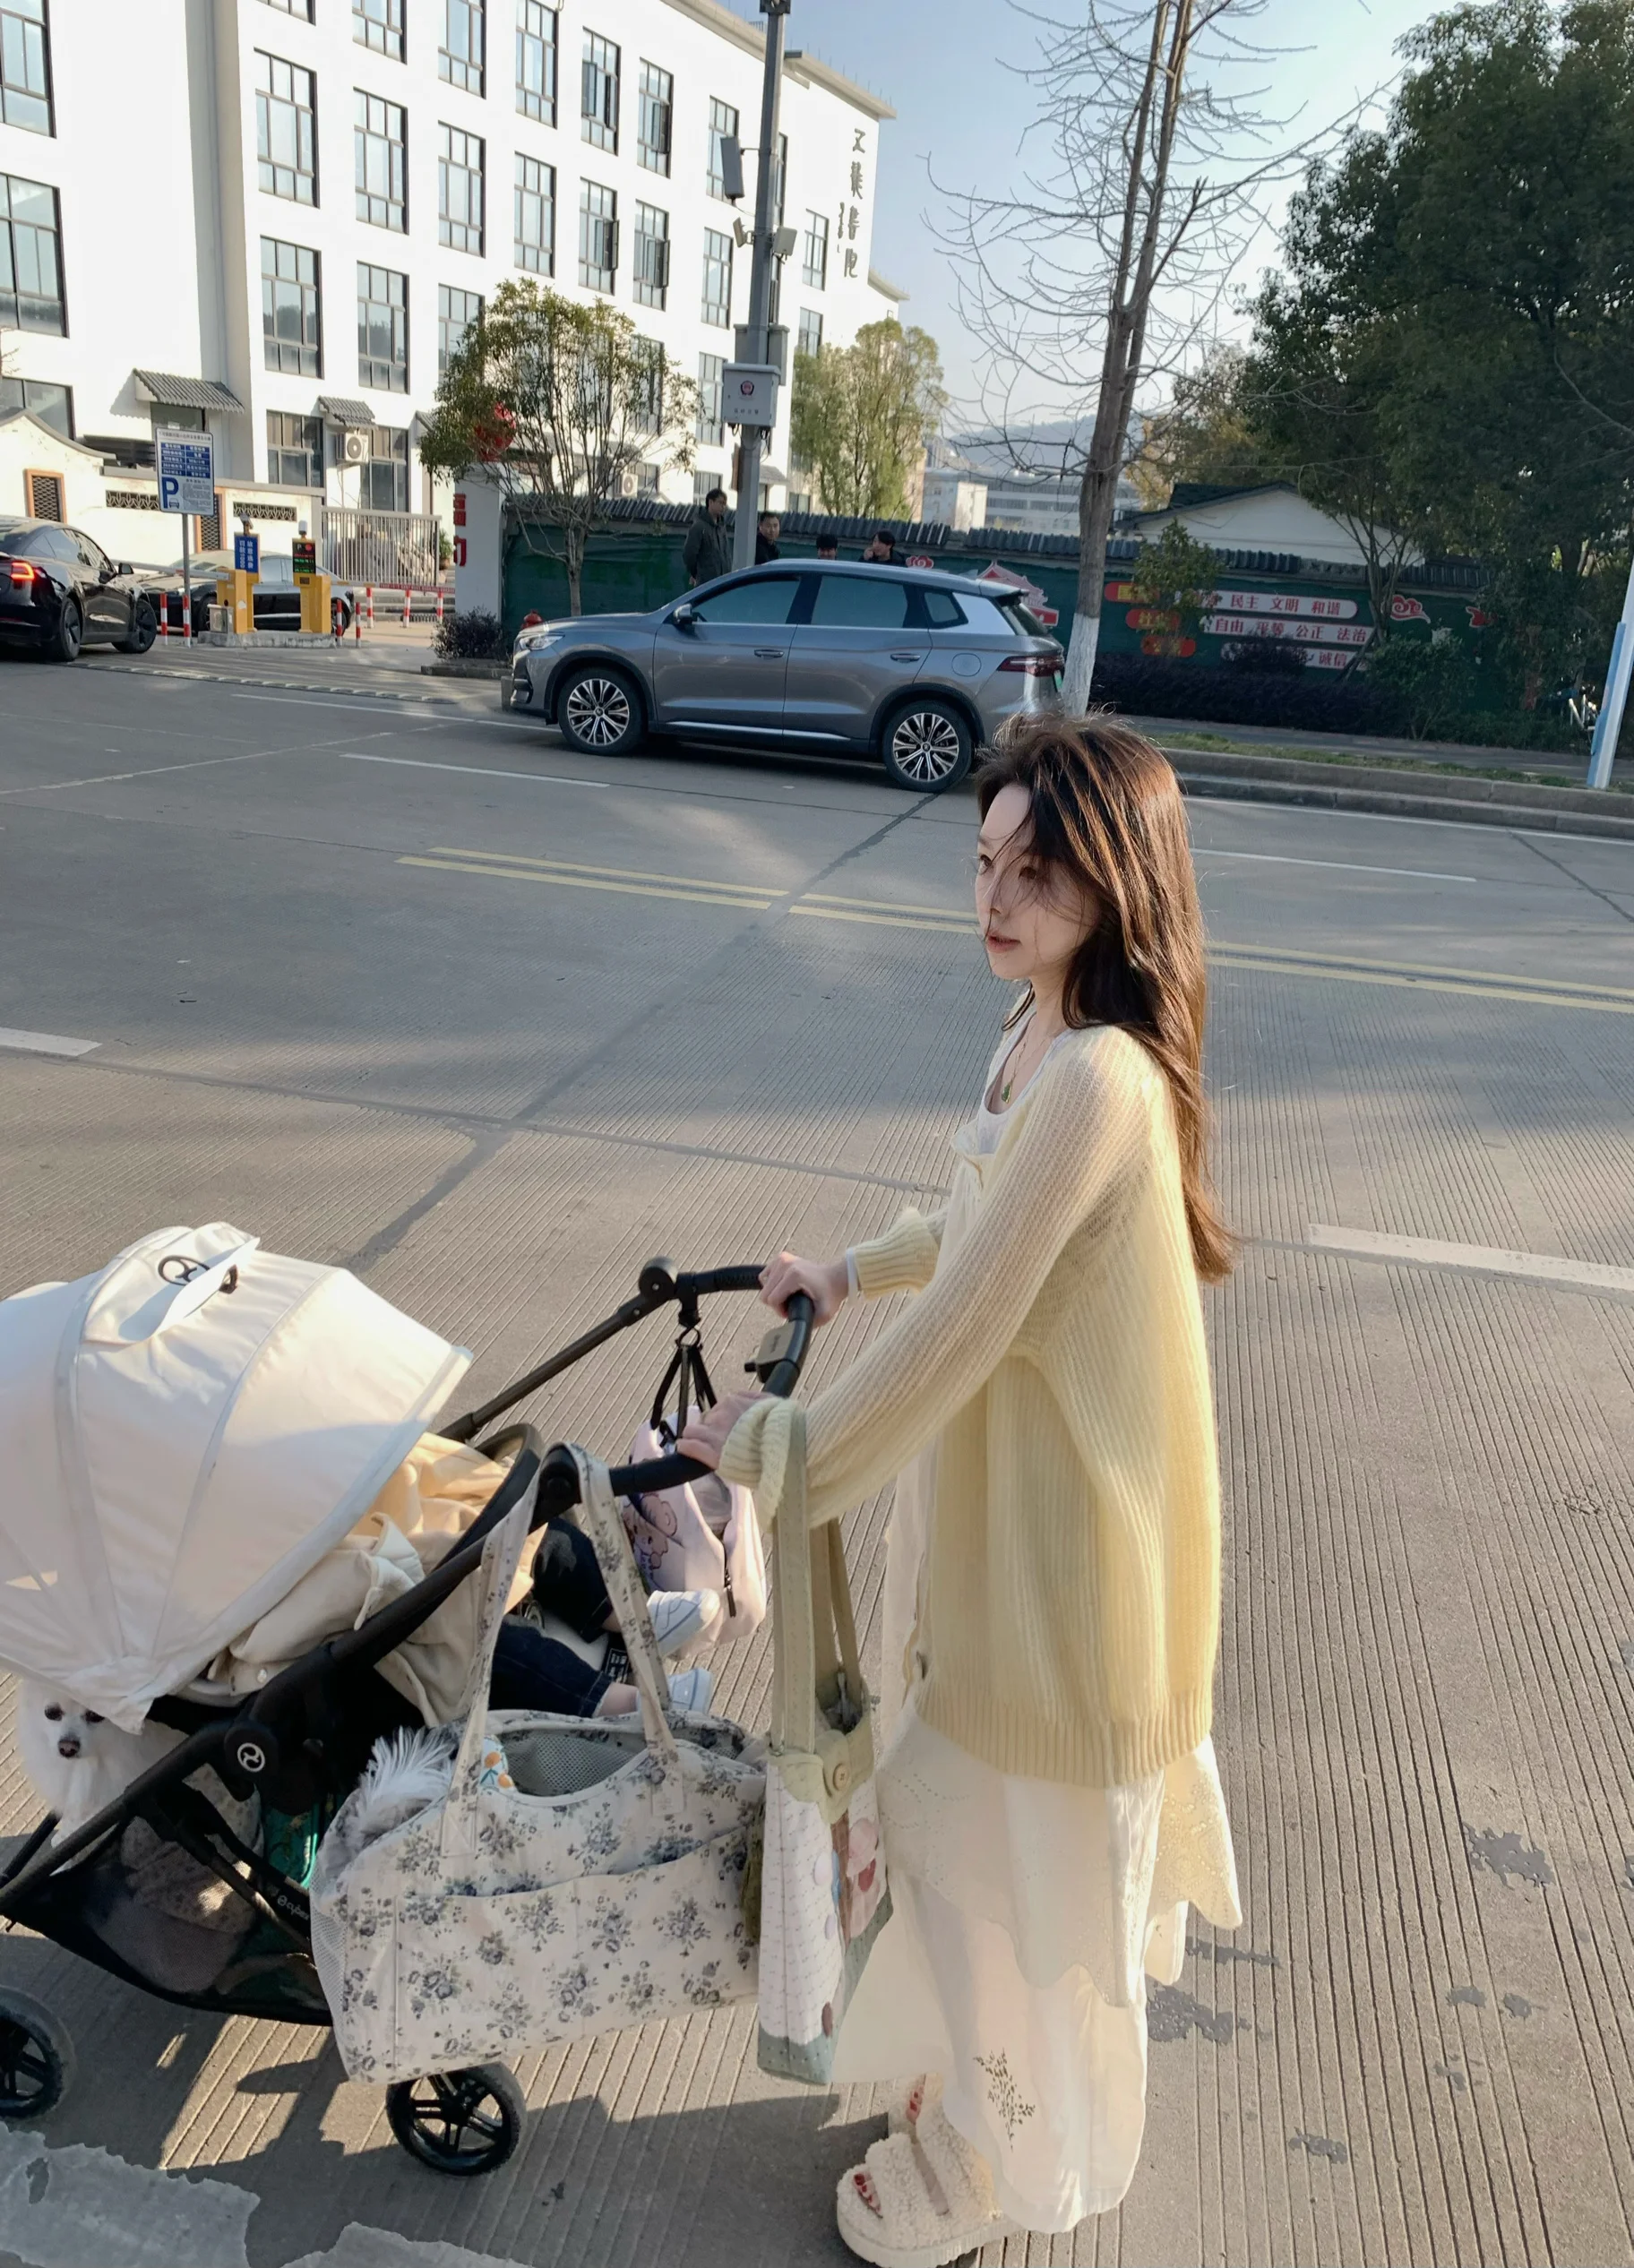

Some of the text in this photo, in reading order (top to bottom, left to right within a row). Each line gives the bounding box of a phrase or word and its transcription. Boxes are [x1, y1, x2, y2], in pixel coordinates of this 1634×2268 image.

[162, 477, 179, 509] P
[1231, 594, 1260, 609] 民主
[1270, 597, 1299, 613] 文明
[1312, 600, 1340, 615] 和谐
[1216, 618, 1243, 633] 自由
[1295, 624, 1323, 640] 公正
[1337, 628, 1367, 642] 法治
[1319, 651, 1347, 666] 诚信
